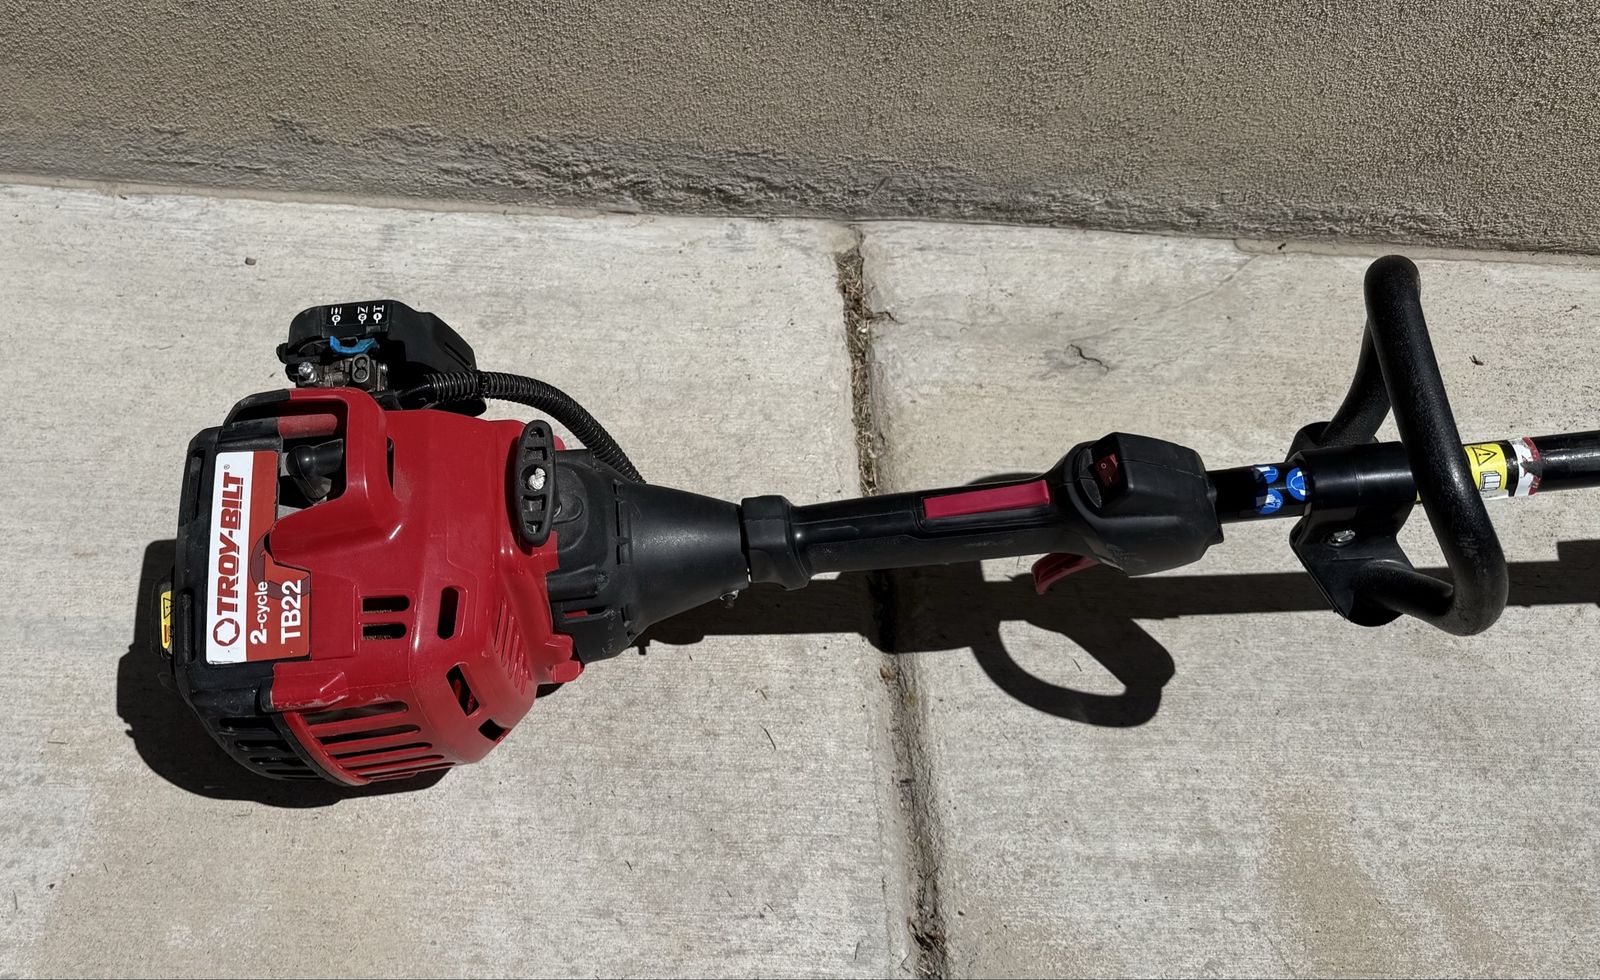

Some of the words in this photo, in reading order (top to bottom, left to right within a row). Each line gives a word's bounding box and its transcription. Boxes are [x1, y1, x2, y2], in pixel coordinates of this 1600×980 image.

[216, 472, 244, 616] TROY-BILT
[250, 581, 270, 645] 2-cycle
[280, 579, 302, 644] TB22
